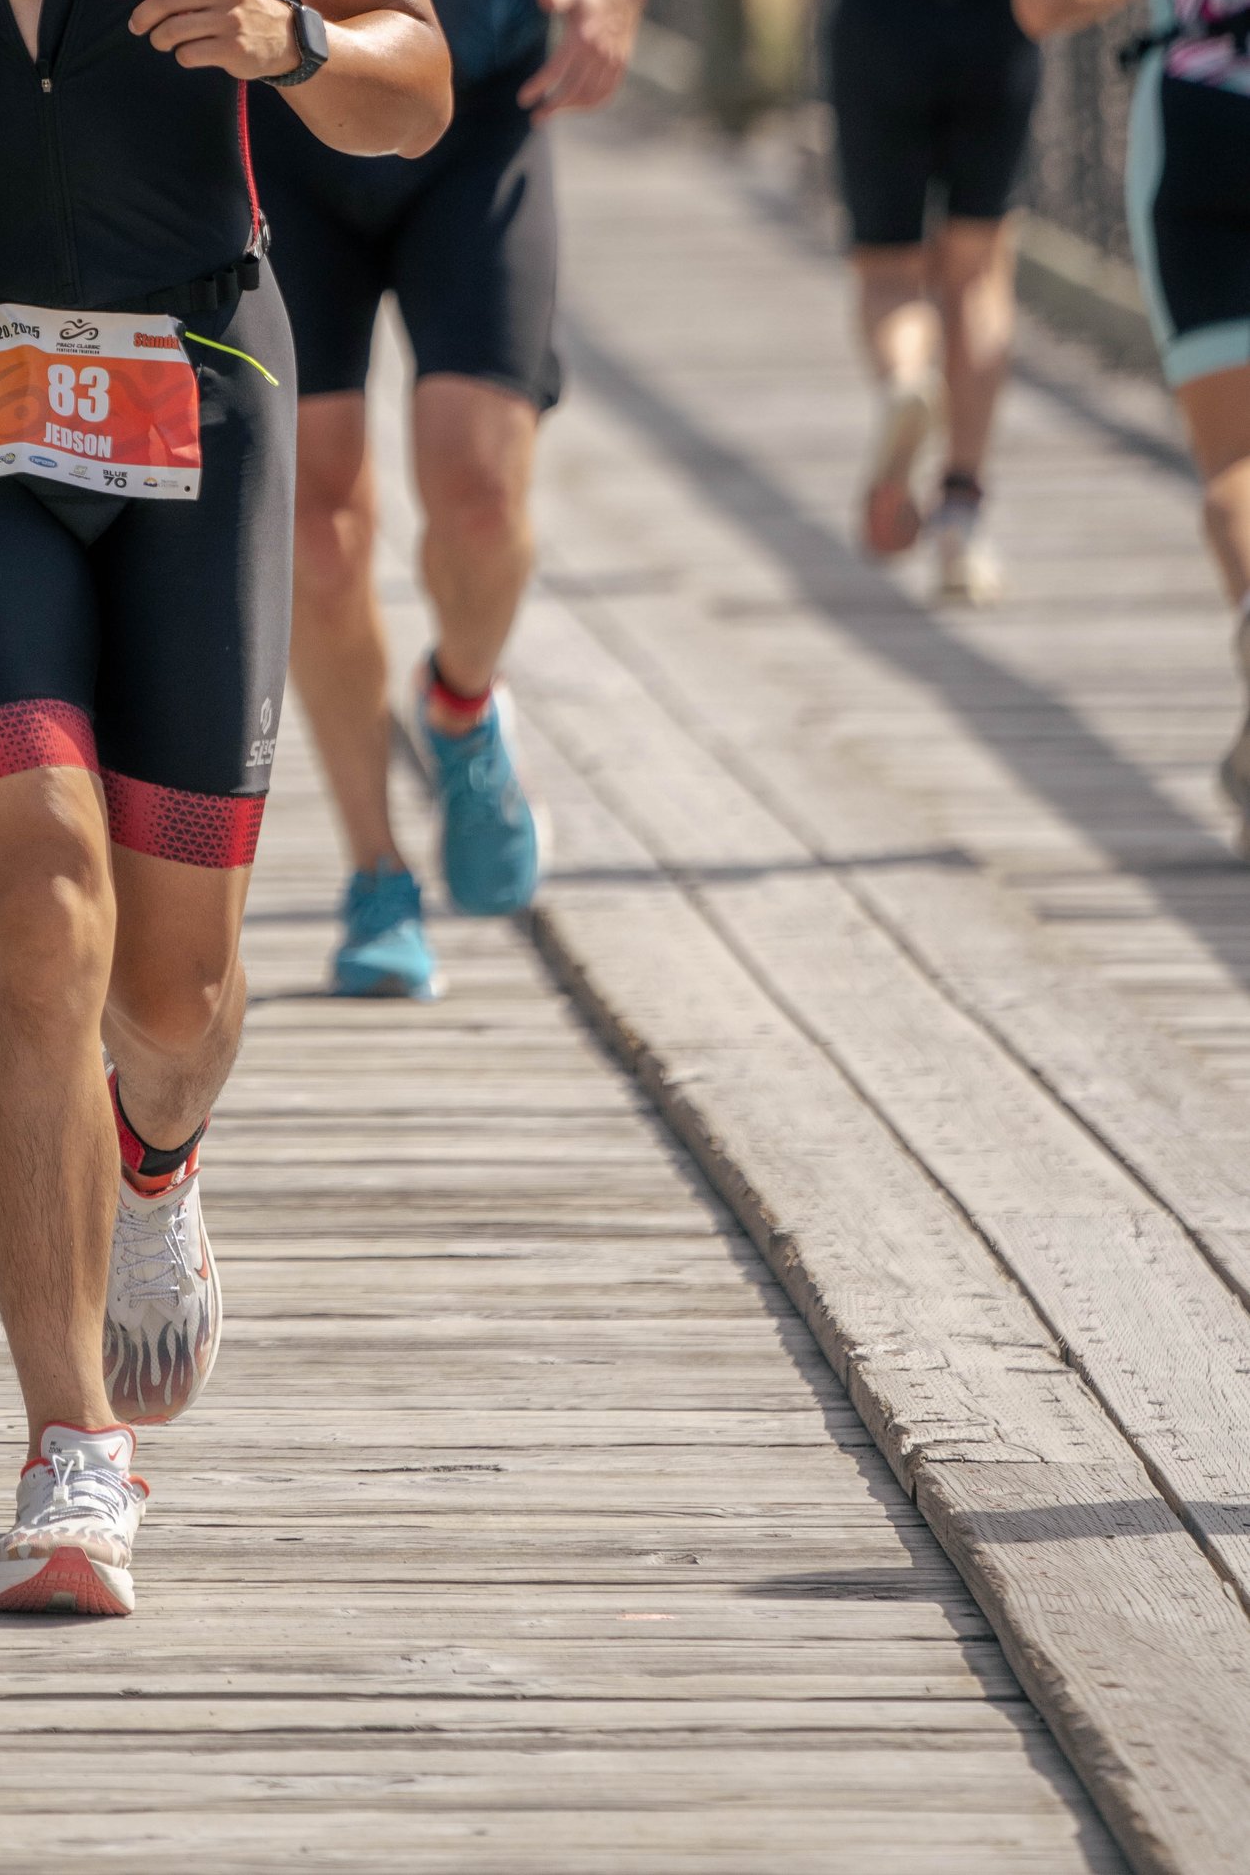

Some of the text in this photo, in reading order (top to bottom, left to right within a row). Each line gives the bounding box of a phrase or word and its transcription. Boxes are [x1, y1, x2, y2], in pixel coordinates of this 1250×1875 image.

[13, 322, 40, 339] 2025
[133, 332, 180, 351] Standa
[47, 364, 110, 423] 83
[43, 422, 112, 458] JEDSON
[103, 469, 128, 478] BLUE
[103, 476, 127, 488] 70
